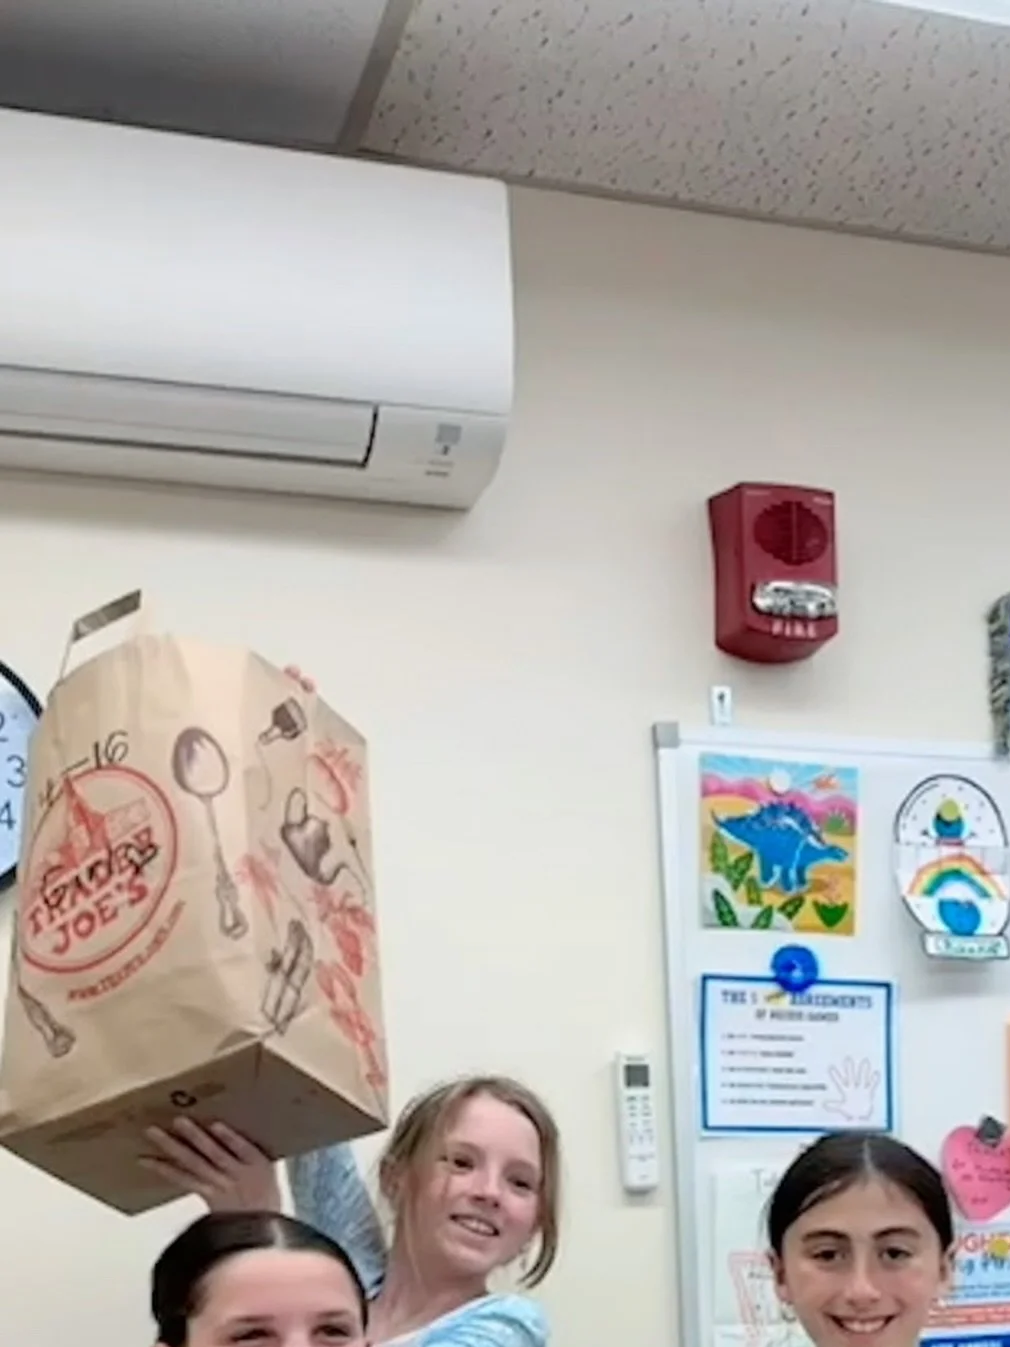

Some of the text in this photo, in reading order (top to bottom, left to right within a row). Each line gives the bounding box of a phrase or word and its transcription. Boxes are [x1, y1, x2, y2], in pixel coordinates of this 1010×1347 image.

[771, 619, 817, 638] FIRE
[6, 754, 27, 788] 3
[0, 801, 17, 830] 4
[28, 826, 160, 935] TRADER
[51, 873, 149, 955] JOE'S
